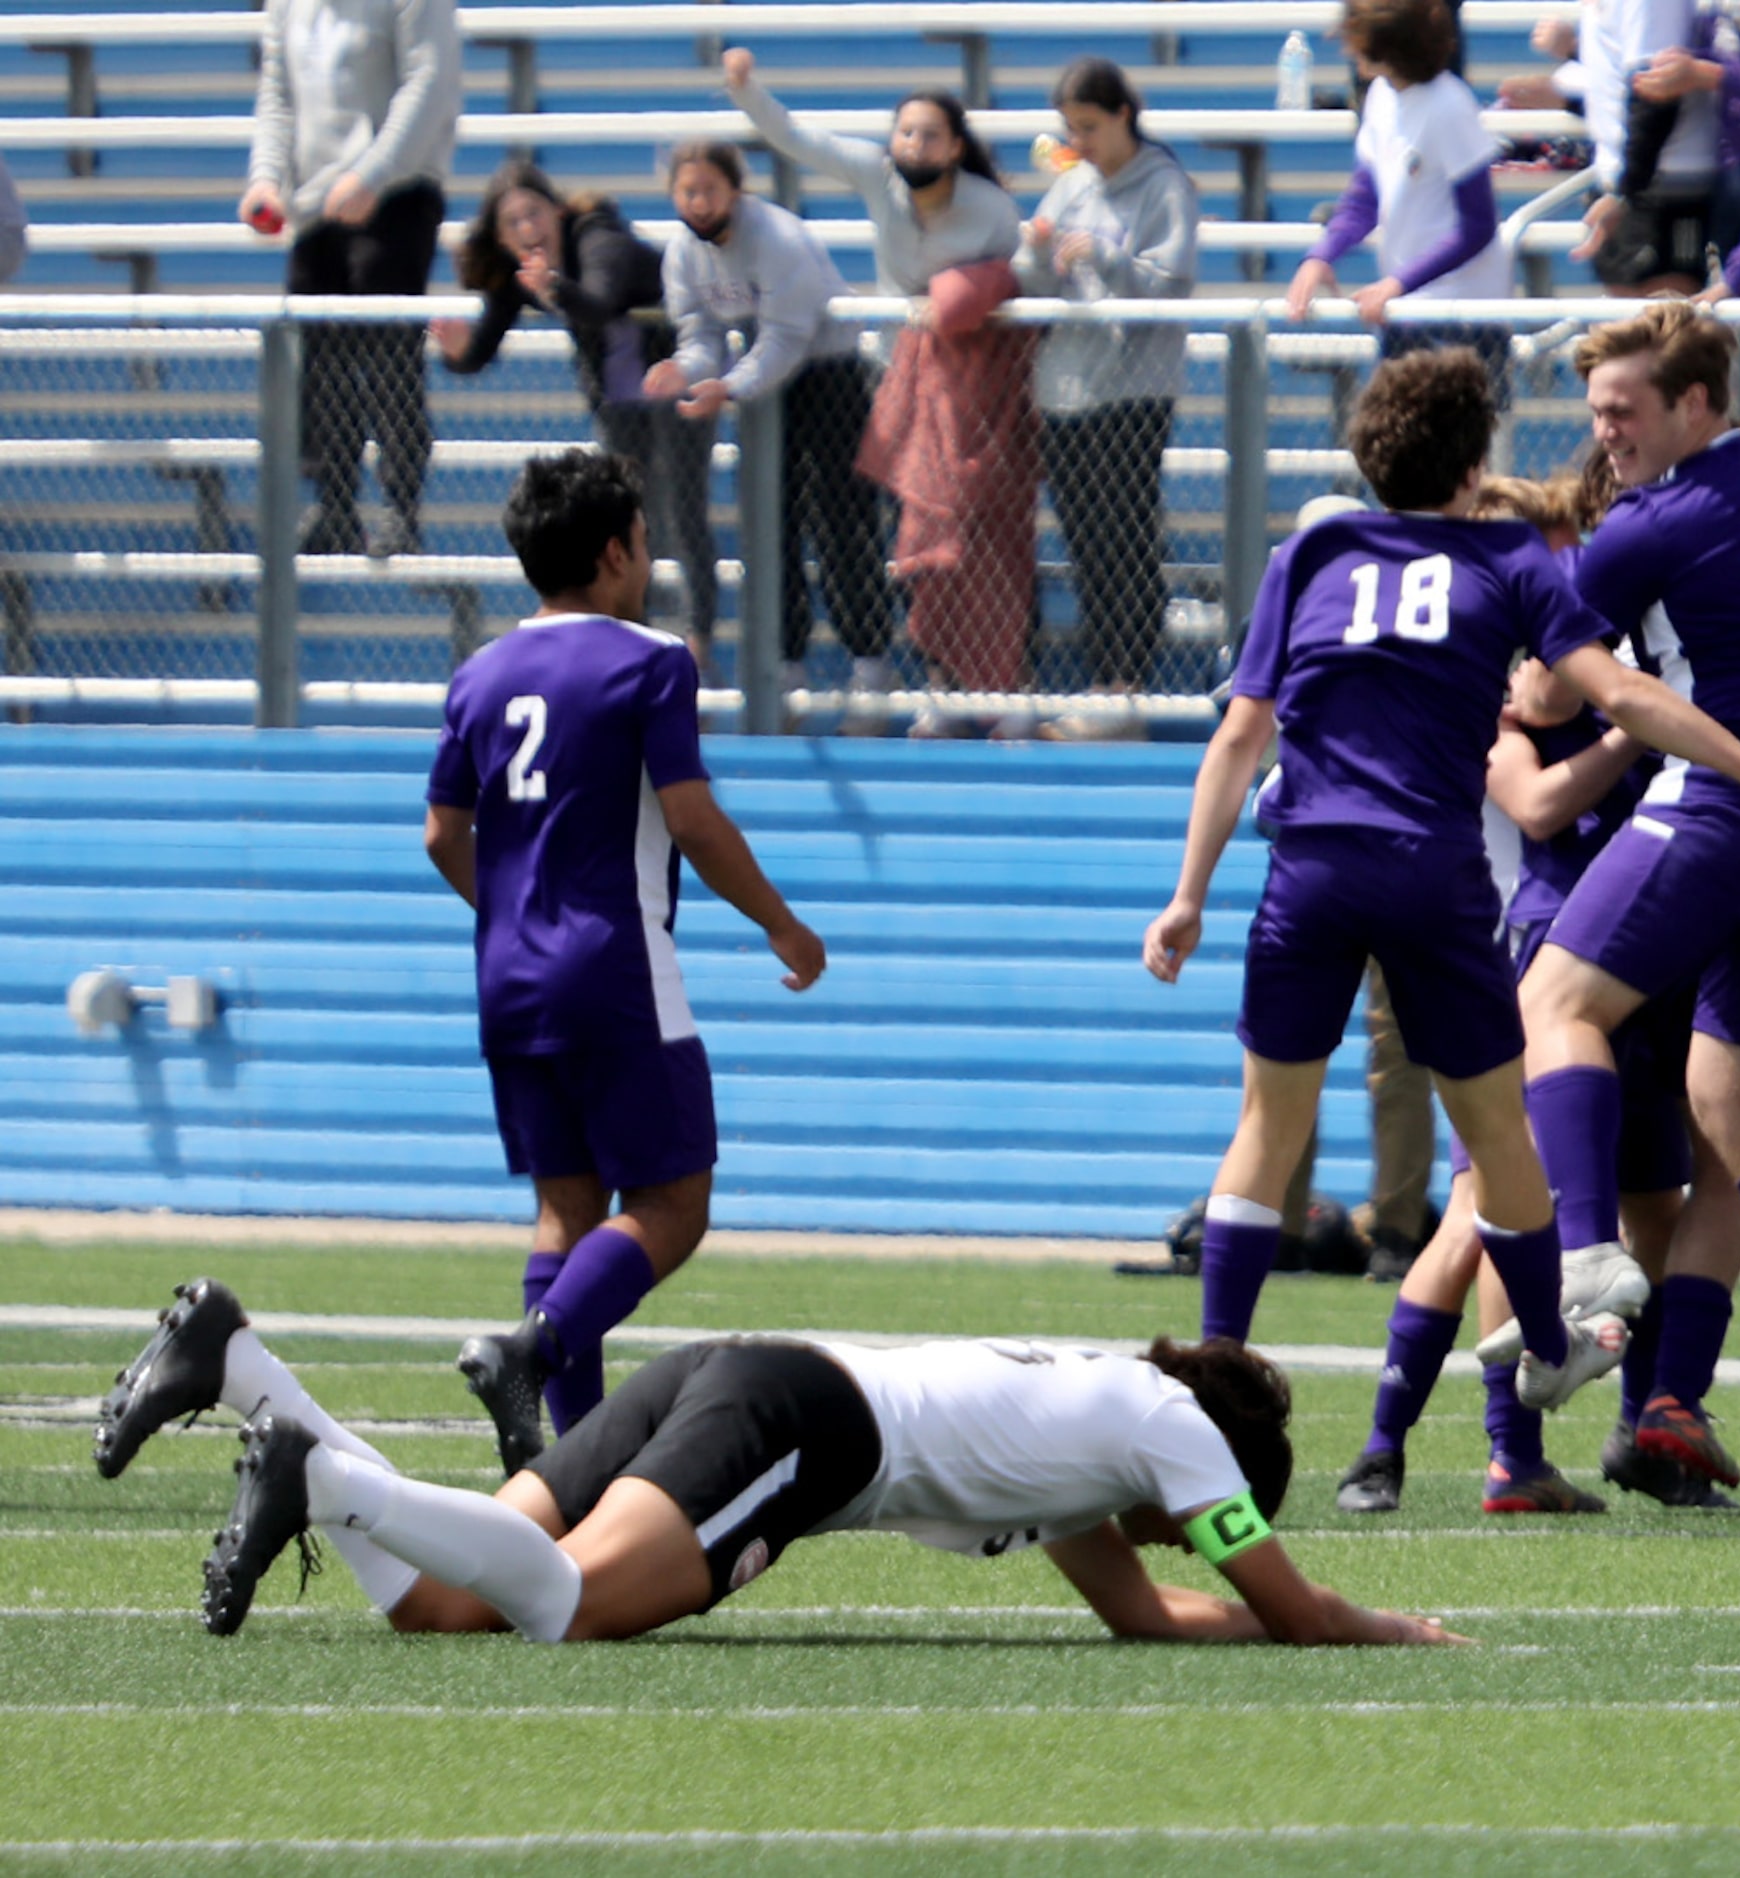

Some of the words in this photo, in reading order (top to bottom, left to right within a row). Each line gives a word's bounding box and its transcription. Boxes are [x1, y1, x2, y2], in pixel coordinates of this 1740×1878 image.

[1341, 552, 1456, 647] 18
[504, 694, 548, 802] 2
[1211, 1502, 1256, 1546] C
